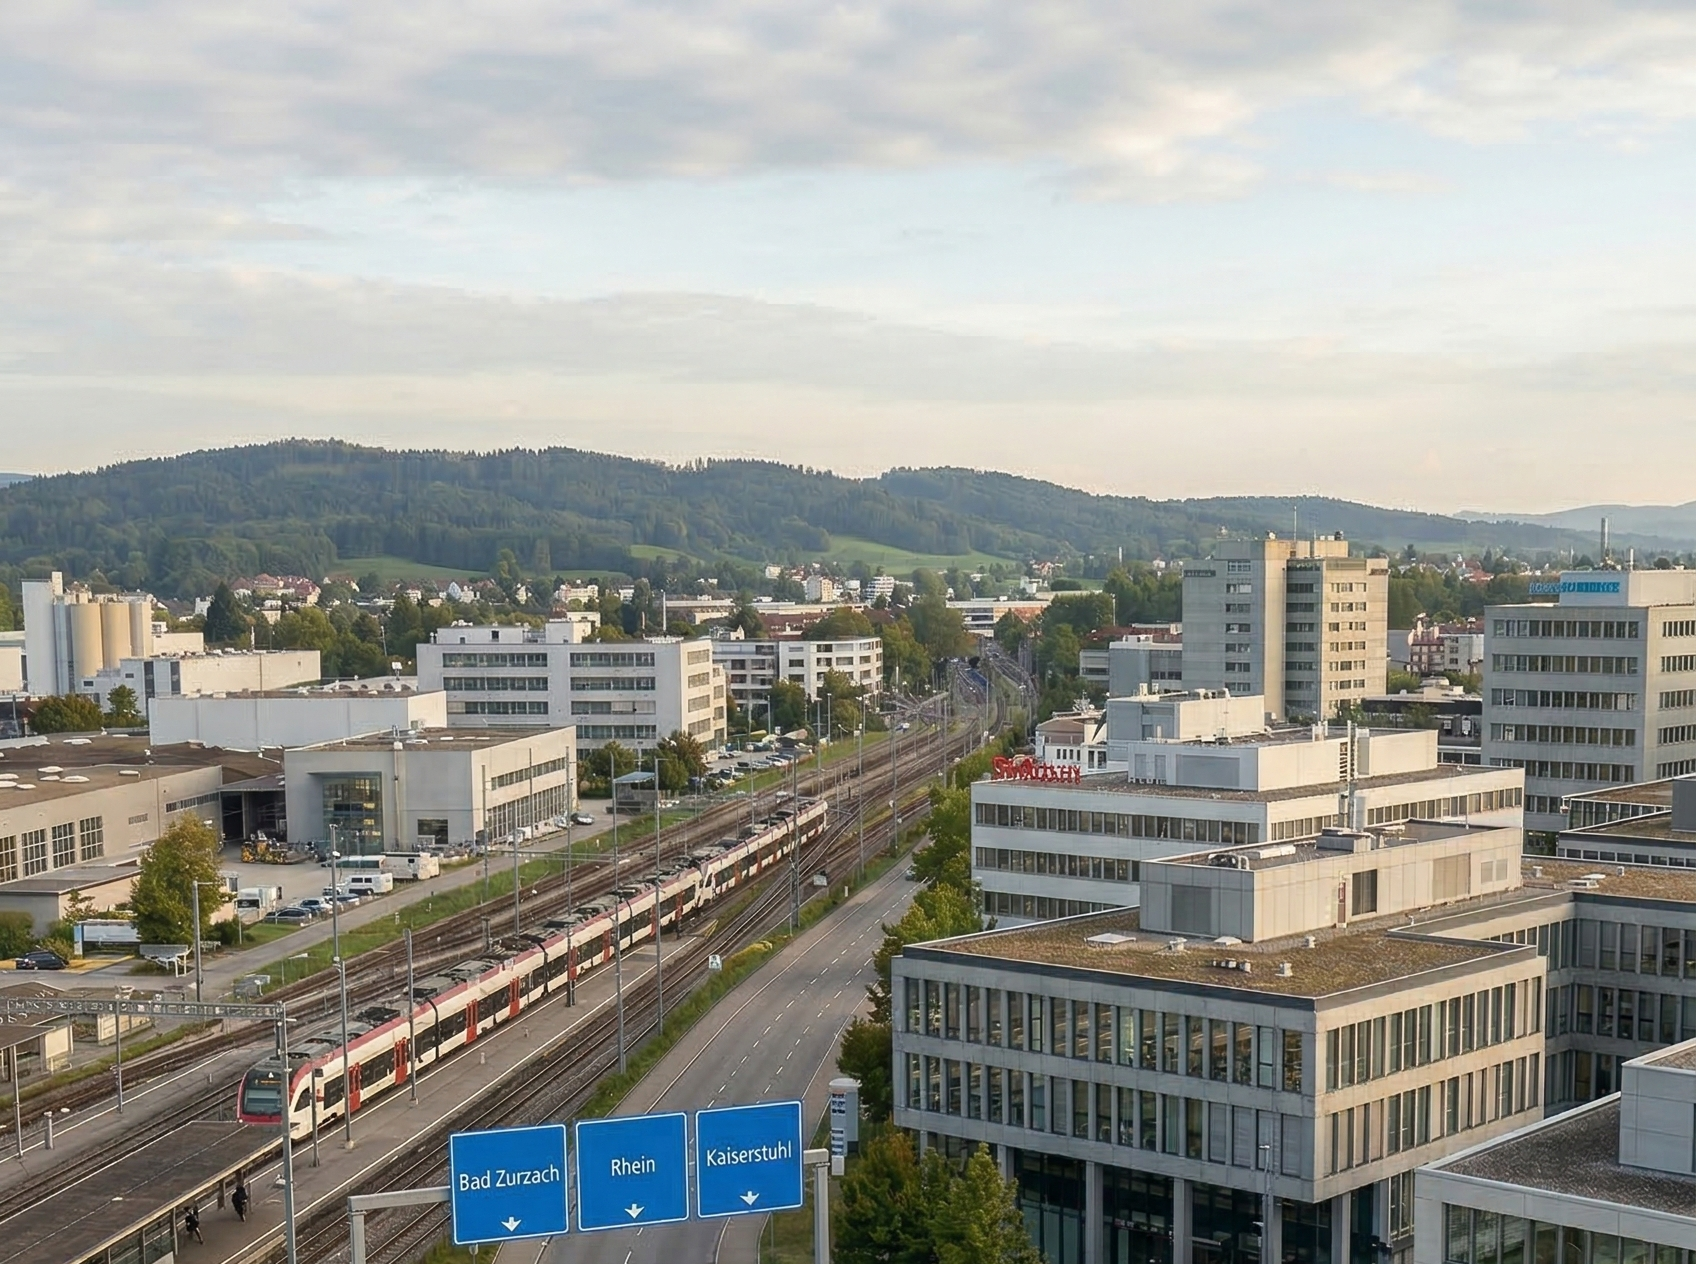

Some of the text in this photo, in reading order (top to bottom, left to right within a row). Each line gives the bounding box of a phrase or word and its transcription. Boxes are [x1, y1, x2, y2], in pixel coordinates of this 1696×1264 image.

[611, 1155, 656, 1177] Rhein
[706, 1140, 792, 1167] Kaiserstuhl
[459, 1163, 560, 1191] Bad Zurzach
